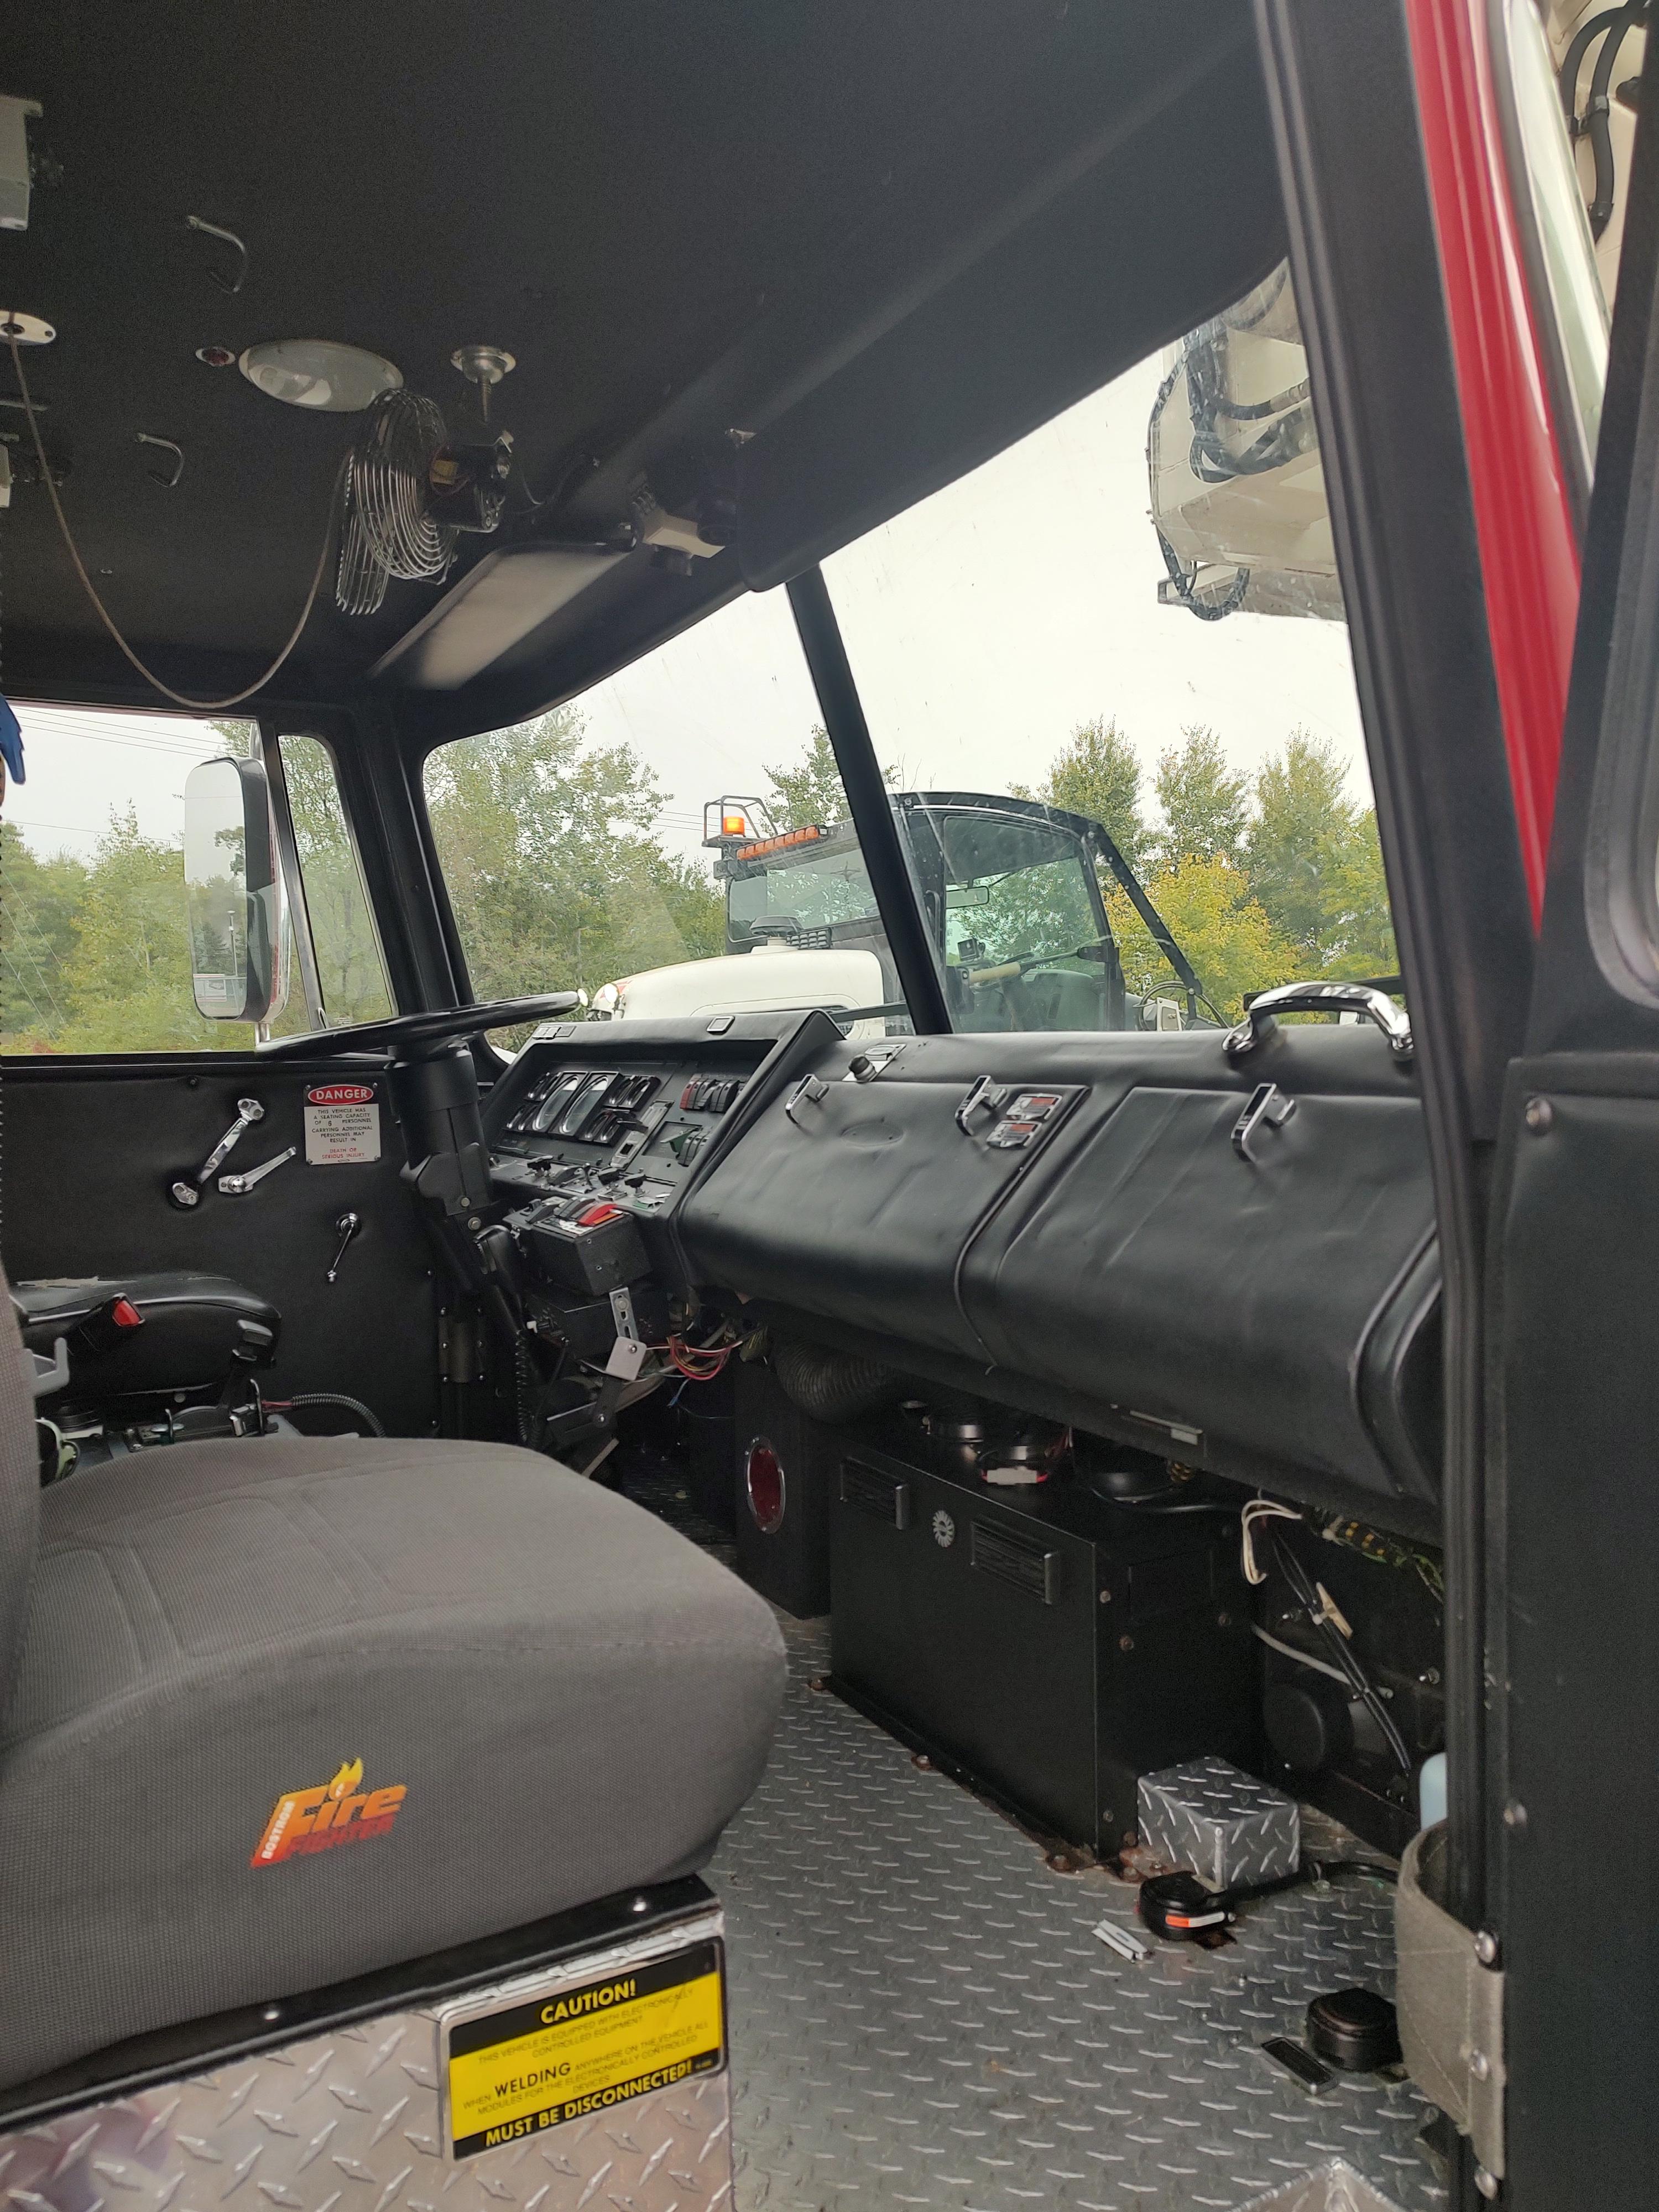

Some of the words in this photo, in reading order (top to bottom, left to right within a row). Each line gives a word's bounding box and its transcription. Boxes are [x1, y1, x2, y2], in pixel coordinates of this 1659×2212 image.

[316, 1089, 367, 1100] DANGER
[250, 1757, 408, 1868] Fire
[541, 1979, 636, 2024] CAUTION!
[478, 2052, 499, 2064] THIS
[502, 2038, 539, 2057] VEHICLE
[551, 2021, 596, 2042] EQUIPPED
[598, 2013, 620, 2025] WITH
[532, 2033, 592, 2058] CONTROLLED
[593, 2016, 643, 2038] EQUIPMENT
[463, 2094, 491, 2109] WHEN
[495, 2062, 571, 2098] WELDING
[575, 2049, 623, 2070] ANYWHERE
[625, 2045, 637, 2054] ON
[640, 2038, 656, 2048] THE
[658, 2026, 692, 2043] VEHICLE
[695, 2021, 708, 2030] ALL
[477, 2094, 523, 2115] MODULES
[525, 2088, 544, 2099] FOR
[546, 2079, 563, 2090] THE
[565, 2054, 640, 2085] ELECTRONICALLY
[641, 2035, 697, 2059] CONTROLLED
[573, 2074, 610, 2093] DEVICES
[486, 2115, 535, 2147] MUST
[539, 2106, 560, 2127] BE
[565, 2060, 693, 2120] DISCONNECTED!
